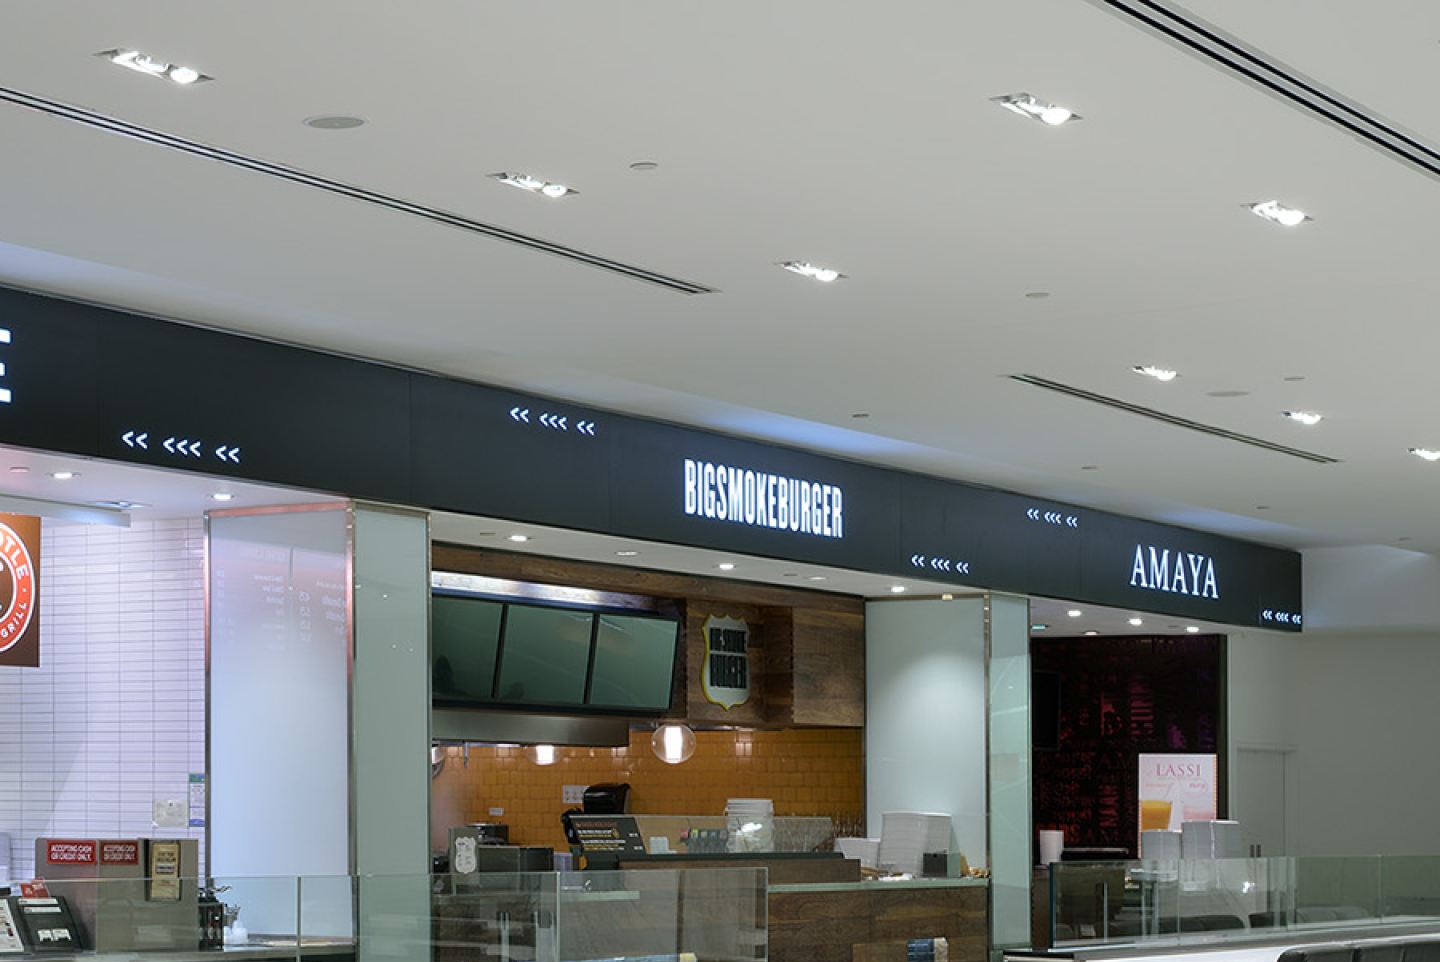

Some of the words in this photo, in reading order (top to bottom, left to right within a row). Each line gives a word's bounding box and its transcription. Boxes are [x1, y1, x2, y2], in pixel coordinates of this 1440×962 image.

[683, 457, 844, 539] BIGSMOKEBURGER
[1129, 543, 1220, 600] AMAYA
[0, 602, 28, 640] GRILL
[1156, 763, 1201, 777] LASSI
